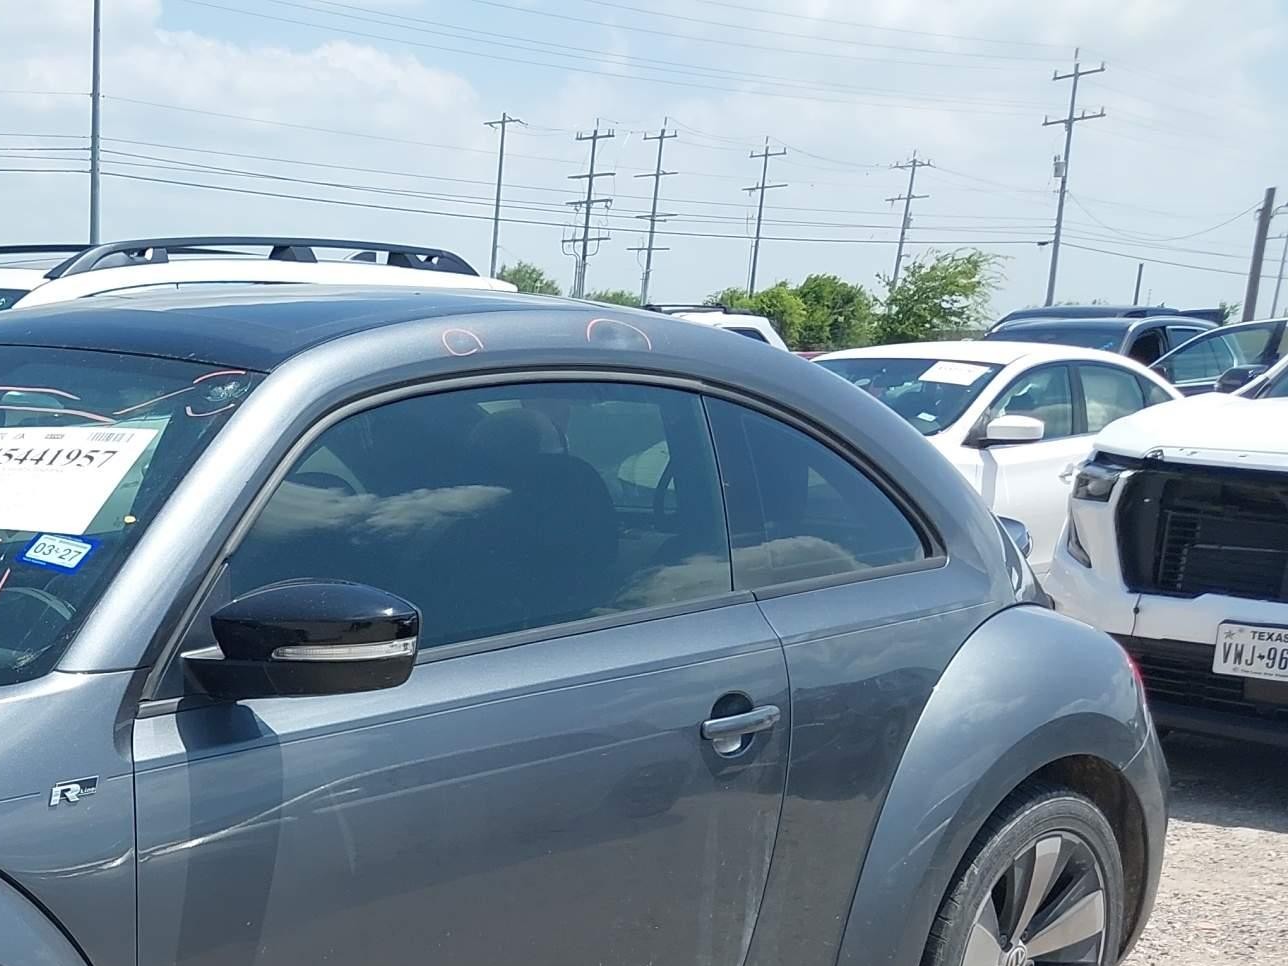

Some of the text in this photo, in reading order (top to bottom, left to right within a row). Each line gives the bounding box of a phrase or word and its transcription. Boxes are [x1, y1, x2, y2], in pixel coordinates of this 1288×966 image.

[33, 542, 55, 556] 03
[58, 548, 82, 562] 27
[1251, 631, 1288, 643] TEXAS
